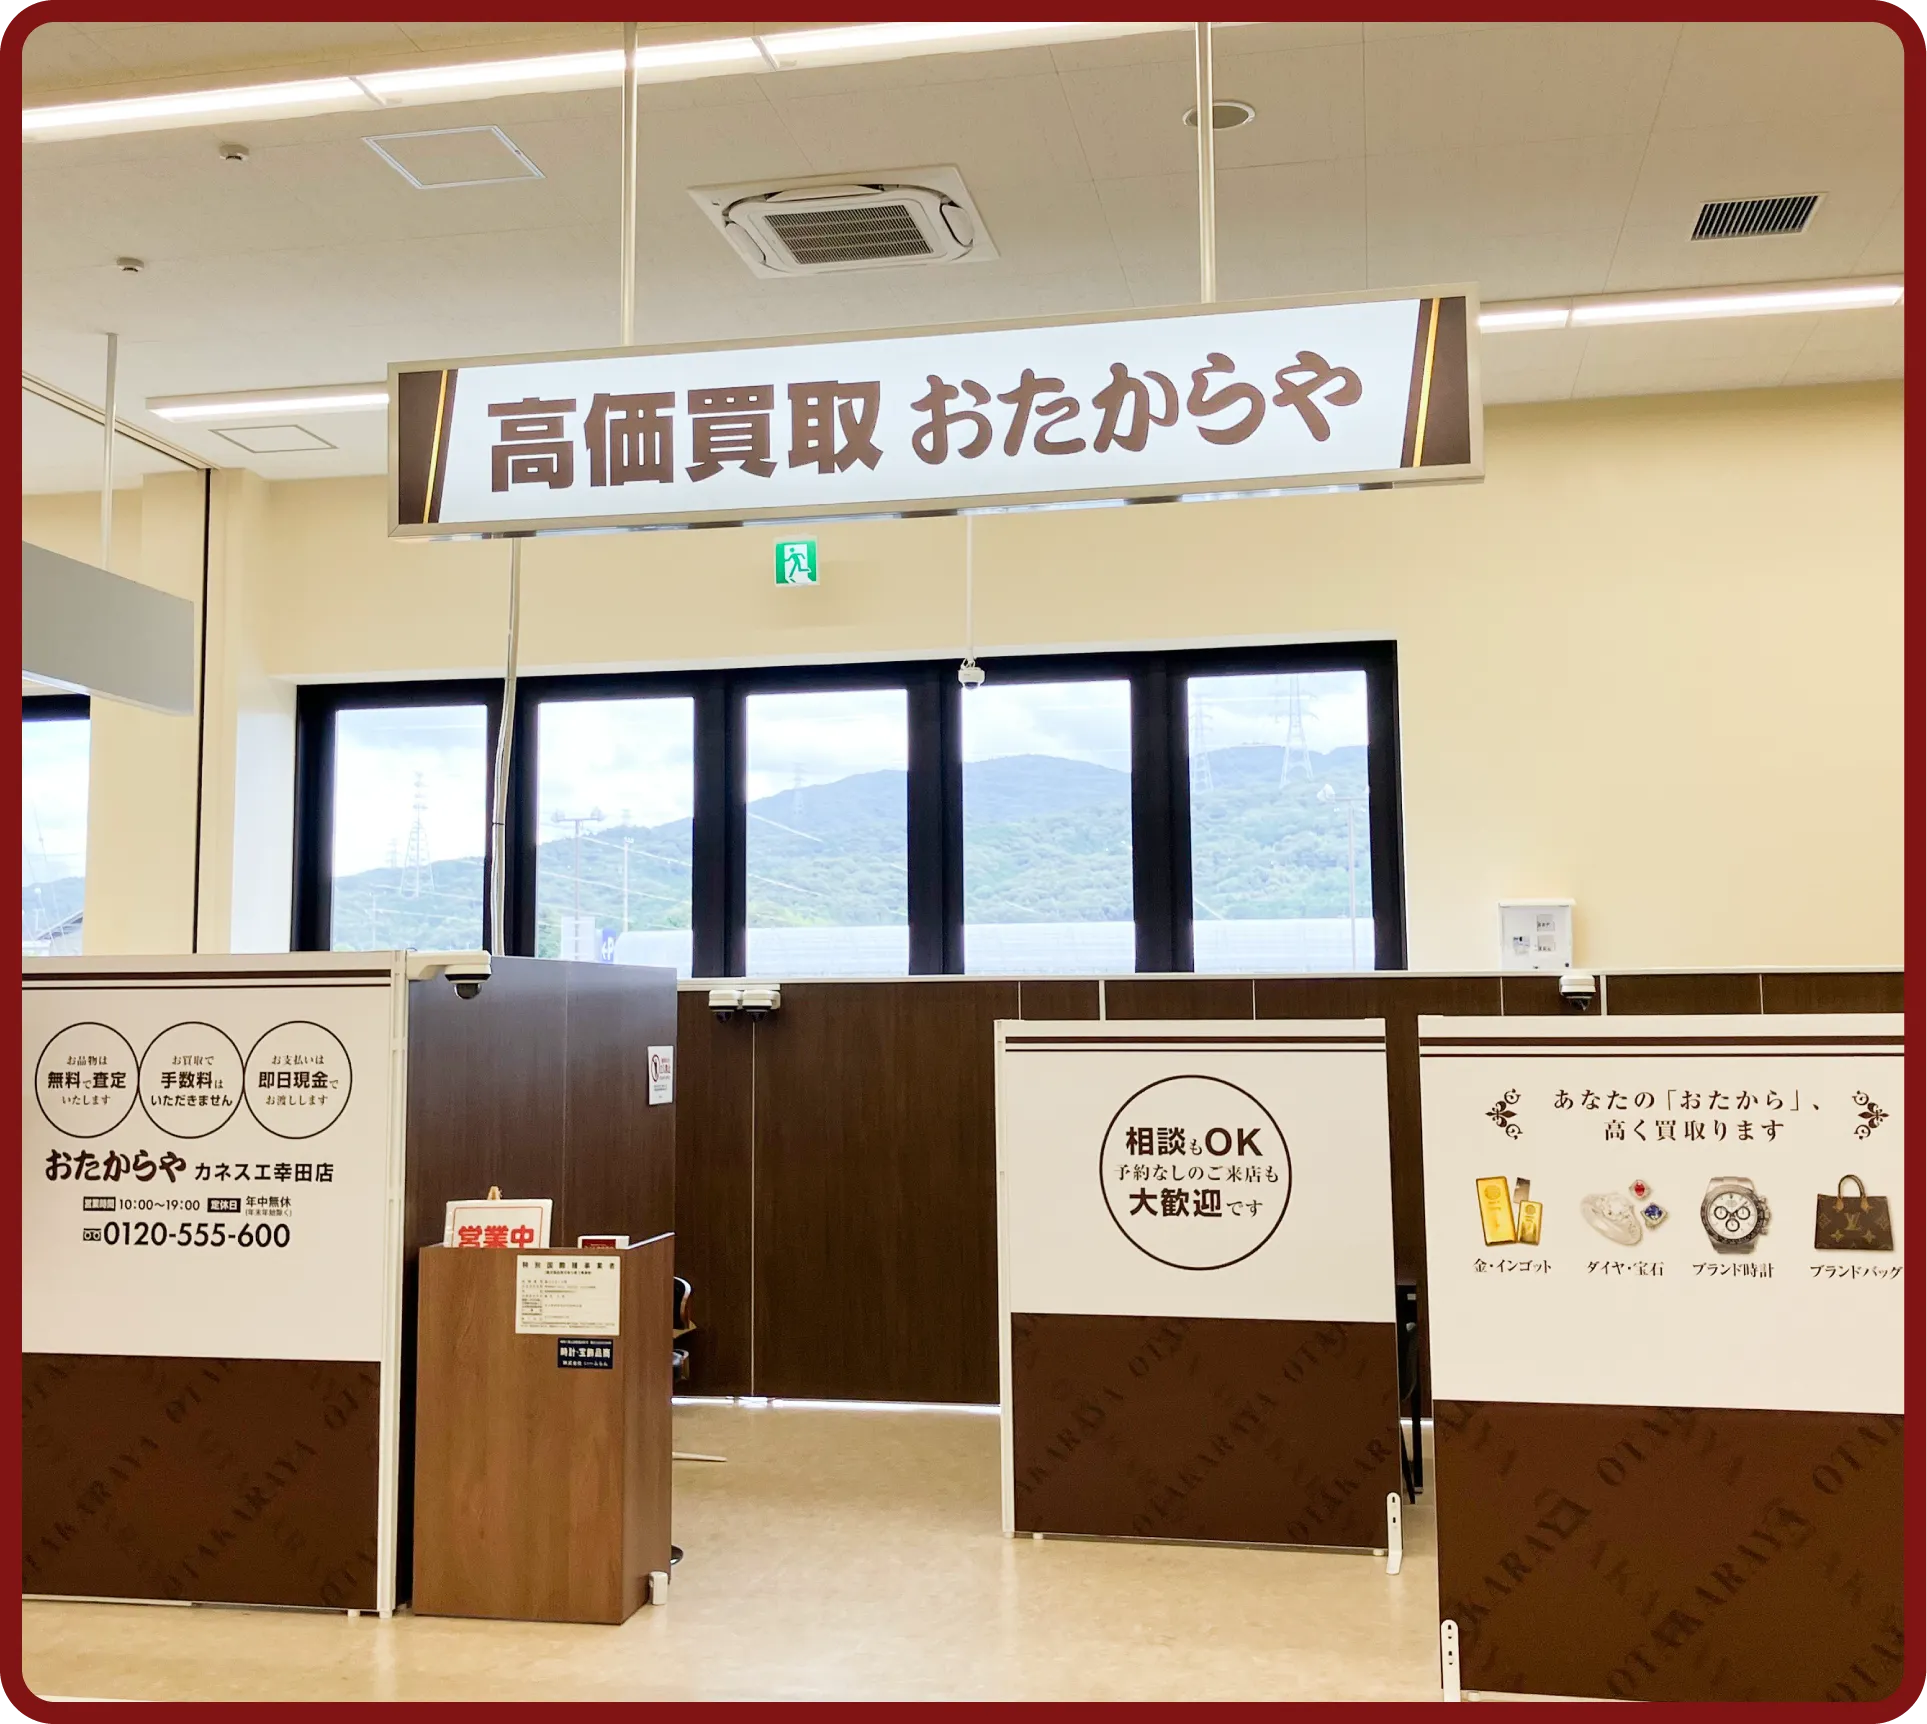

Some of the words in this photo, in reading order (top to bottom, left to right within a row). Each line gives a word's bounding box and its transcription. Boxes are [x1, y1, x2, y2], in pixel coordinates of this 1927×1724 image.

[487, 380, 884, 493] 高価買取
[910, 351, 1364, 465] おたからや
[66, 1055, 108, 1067] お品物は
[172, 1055, 215, 1067] お買取で
[271, 1054, 325, 1066] お支払いは
[47, 1071, 127, 1090] 無料で査定
[160, 1071, 224, 1090] 手数料は
[258, 1070, 339, 1090] 即日現金で
[61, 1094, 111, 1106] いたします
[151, 1094, 233, 1107] いただきません
[265, 1094, 329, 1106] お渡しします
[1604, 1119, 1785, 1142] 高く買取ります
[44, 1148, 187, 1183] おたからや
[194, 1162, 335, 1184] カネスエ幸田店
[1114, 1163, 1280, 1183] 予約なしのご来店も
[245, 1195, 292, 1208] 年中無休
[1128, 1187, 1264, 1218] 大歓迎です
[103, 1221, 291, 1248] 0120-555-600
[458, 1224, 535, 1248] 営業中
[1692, 1263, 1774, 1278] ブランド時計
[1809, 1265, 1903, 1280] ブランドバッグ
